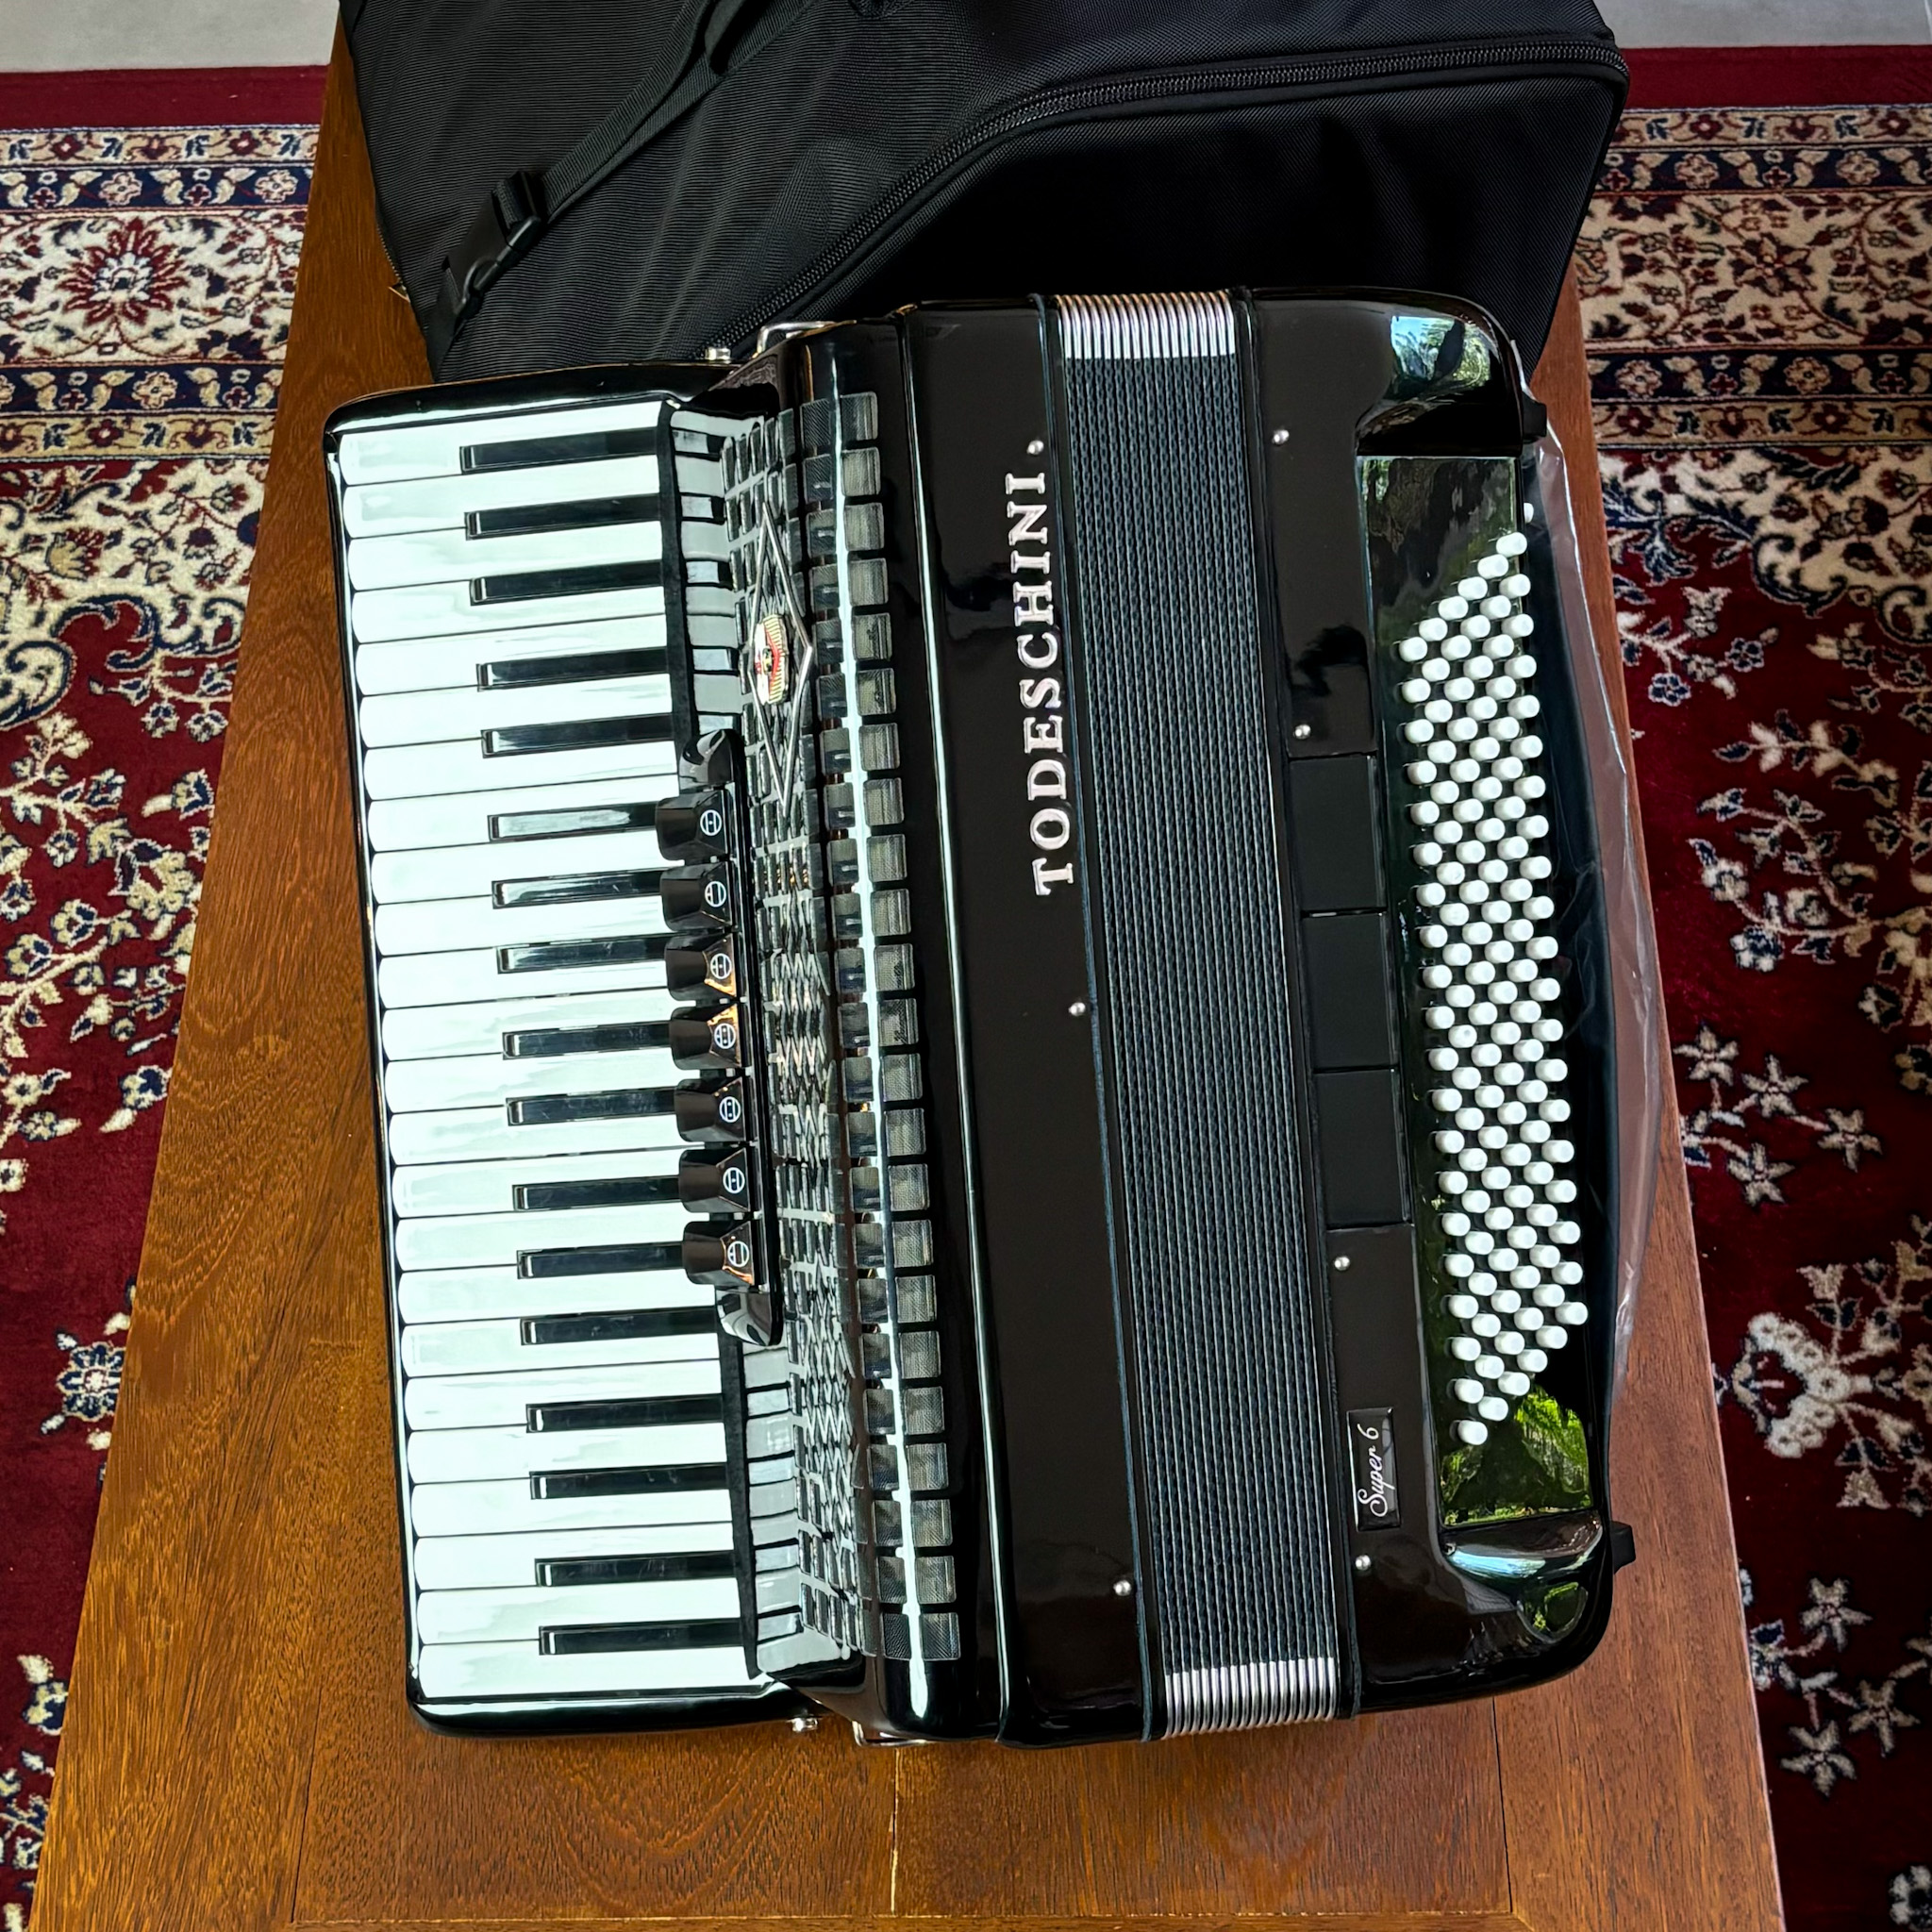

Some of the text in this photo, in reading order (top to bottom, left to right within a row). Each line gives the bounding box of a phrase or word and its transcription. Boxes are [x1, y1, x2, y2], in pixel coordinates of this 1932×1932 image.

[1005, 473, 1074, 896] TODESCHINI
[1357, 1424, 1395, 1517] Super 6
